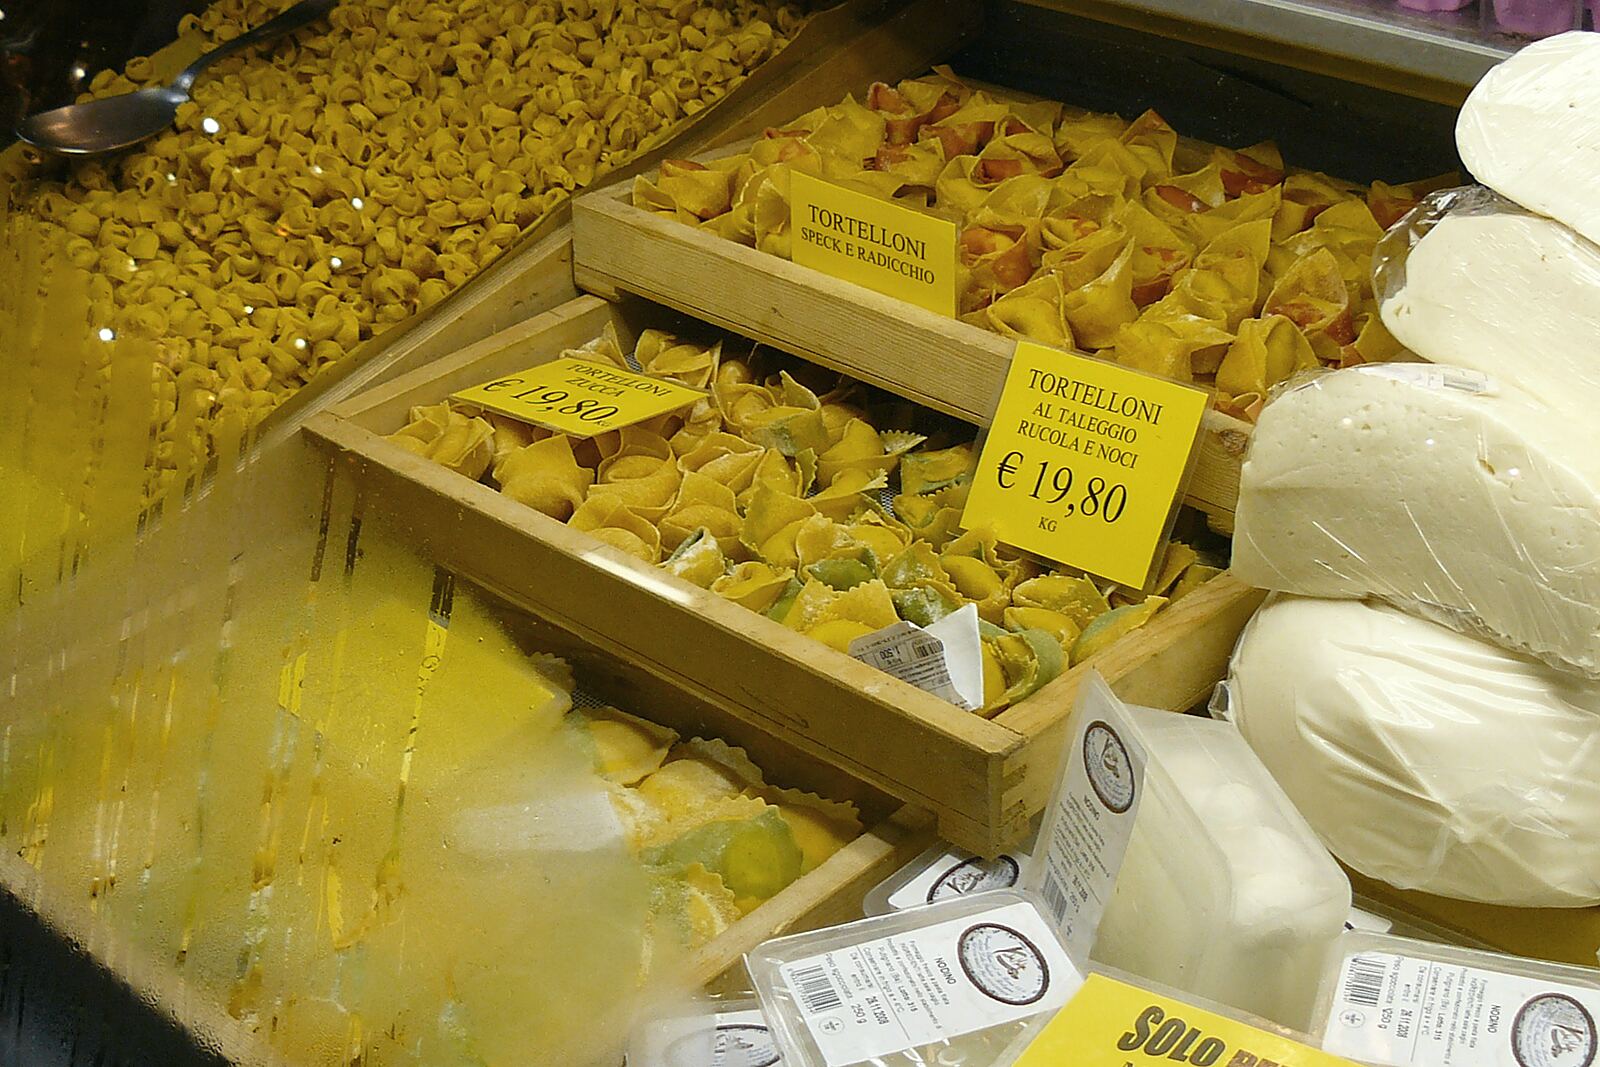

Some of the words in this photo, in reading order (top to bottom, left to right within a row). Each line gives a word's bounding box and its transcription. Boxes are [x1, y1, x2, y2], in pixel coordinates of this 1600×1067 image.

[807, 204, 927, 260] TORTELLONI
[801, 227, 842, 253] SPECK
[845, 243, 855, 257] E
[857, 246, 935, 285] RADICCHIO
[483, 378, 524, 392] €
[510, 385, 619, 422] 19,80
[566, 364, 672, 397] TORTELLONI
[566, 377, 626, 397] ZUCCA
[1028, 369, 1163, 425] TORTELLONI
[1017, 420, 1079, 452] RUCOLA
[1083, 440, 1096, 456] E
[1097, 443, 1139, 469] NOCI
[1032, 402, 1052, 420] AL
[1058, 407, 1137, 444] TALEGGIO
[997, 451, 1024, 489] €
[1028, 461, 1127, 523] 19,80
[1038, 516, 1058, 533] KG
[933, 957, 957, 985] NODINO
[850, 1003, 866, 1018] 250
[1487, 1004, 1499, 1033] NODINO
[1117, 1005, 1226, 1067] SOLO
